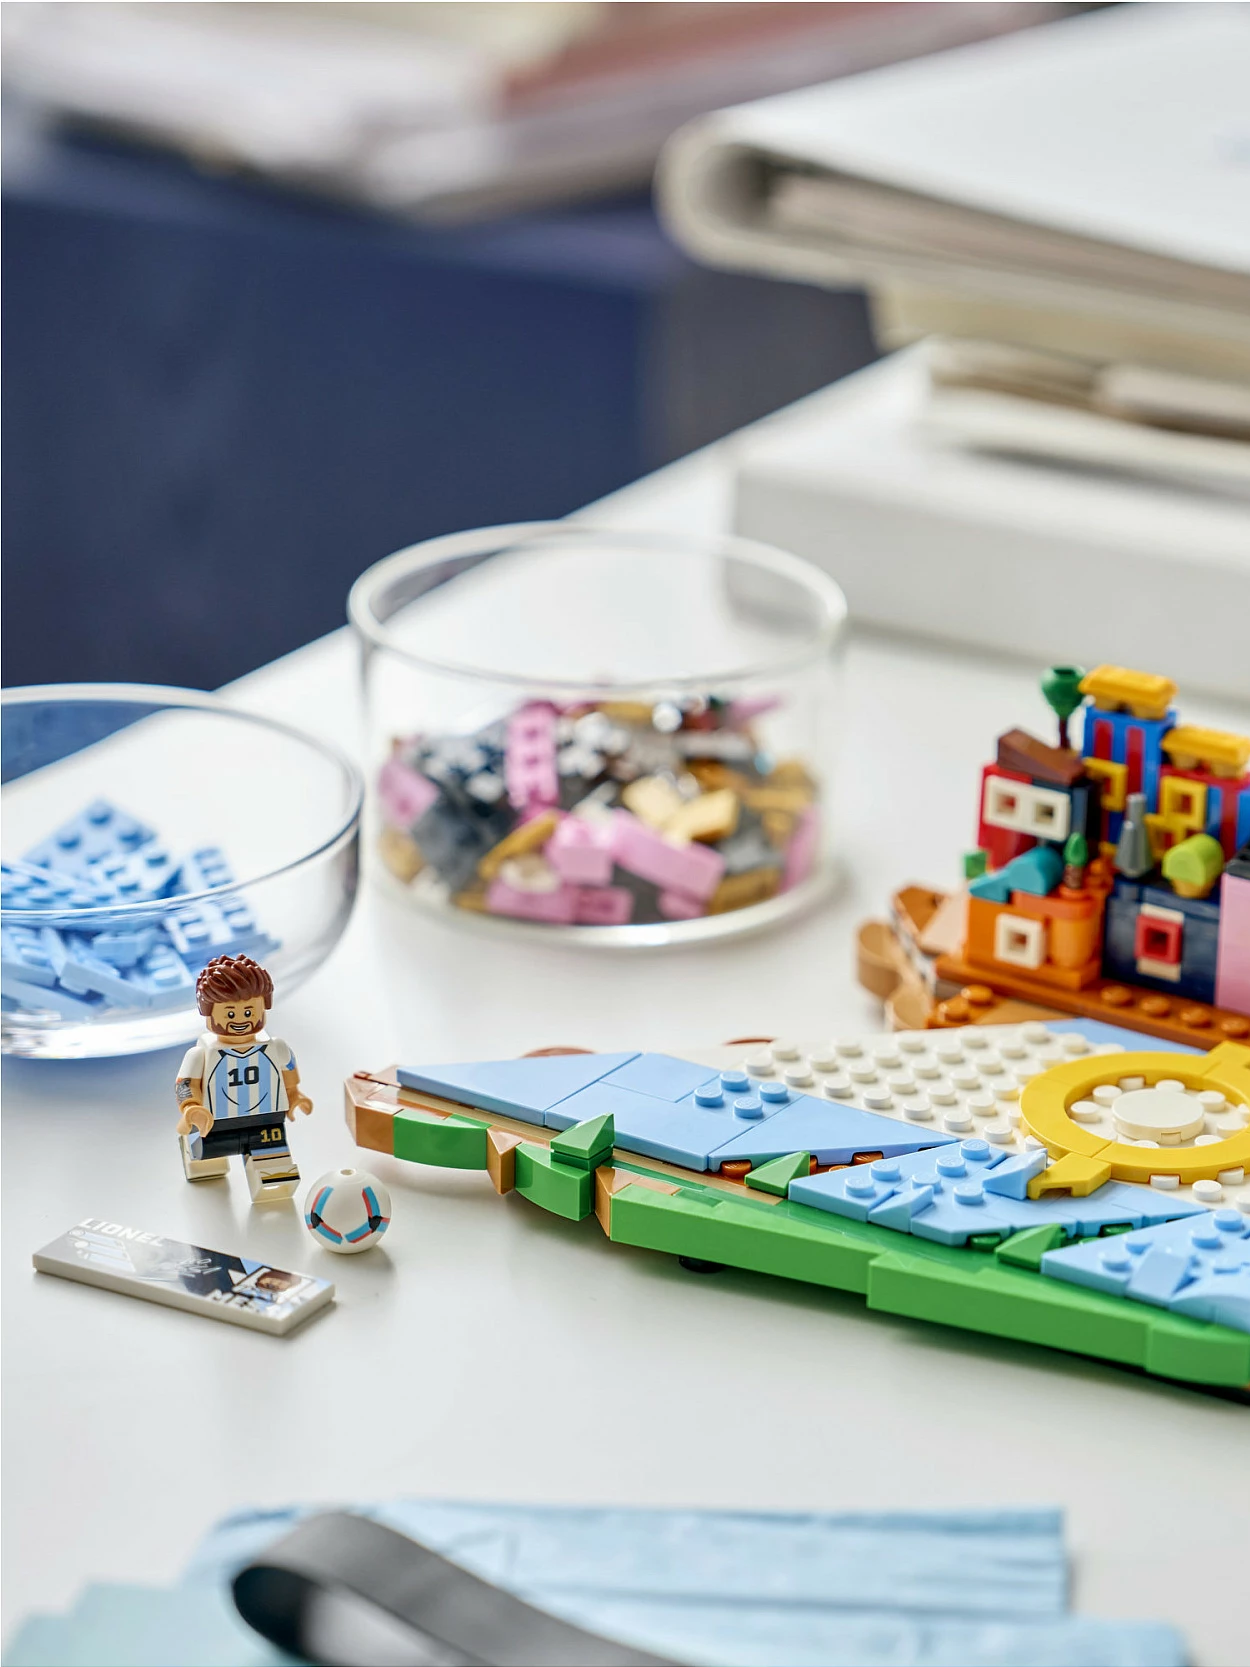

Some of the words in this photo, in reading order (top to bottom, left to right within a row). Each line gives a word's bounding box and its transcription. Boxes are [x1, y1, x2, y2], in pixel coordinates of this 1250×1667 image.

[228, 1065, 259, 1087] 10
[260, 1127, 282, 1143] 10
[80, 1217, 163, 1247] LIONEL
